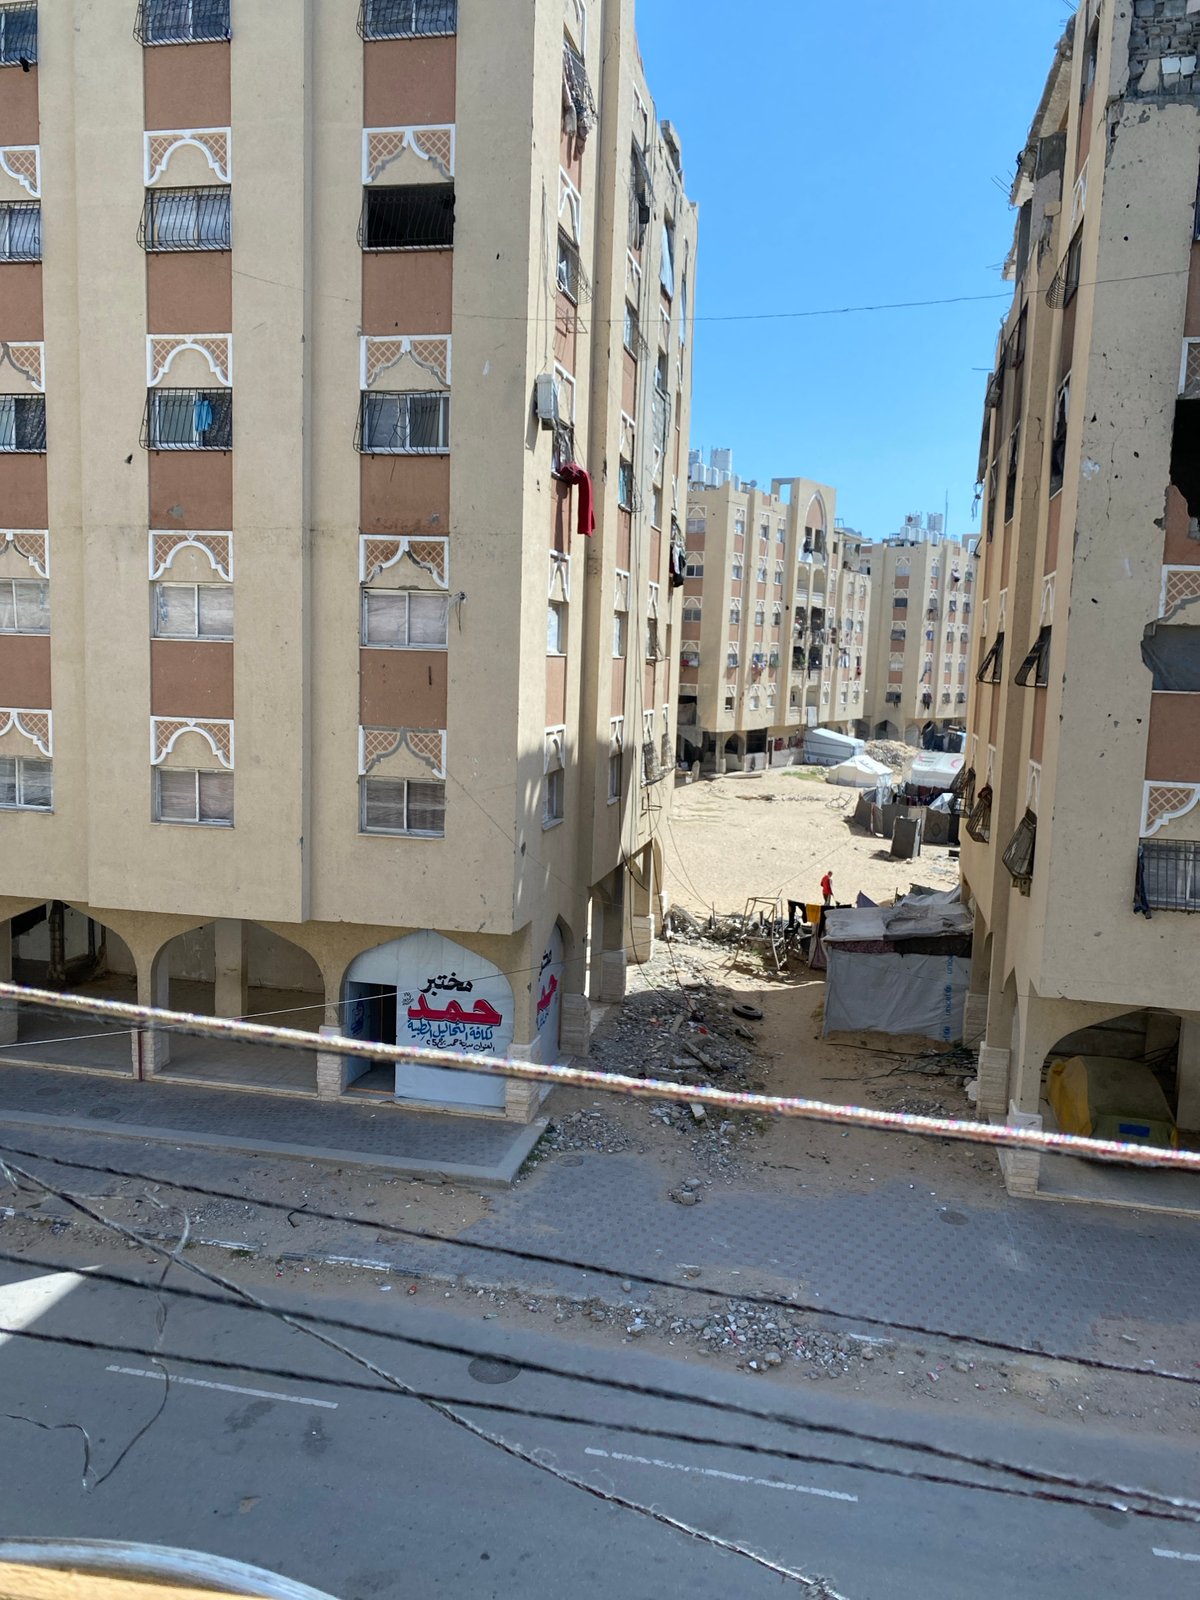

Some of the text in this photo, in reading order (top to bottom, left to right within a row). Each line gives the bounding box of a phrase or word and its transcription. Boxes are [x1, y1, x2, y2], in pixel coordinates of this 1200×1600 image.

[417, 972, 474, 996] مختبر
[407, 993, 503, 1026] حمد
[407, 1018, 494, 1041] لكافة التحاليل الطبية
[473, 1041, 496, 1052] العنوان
